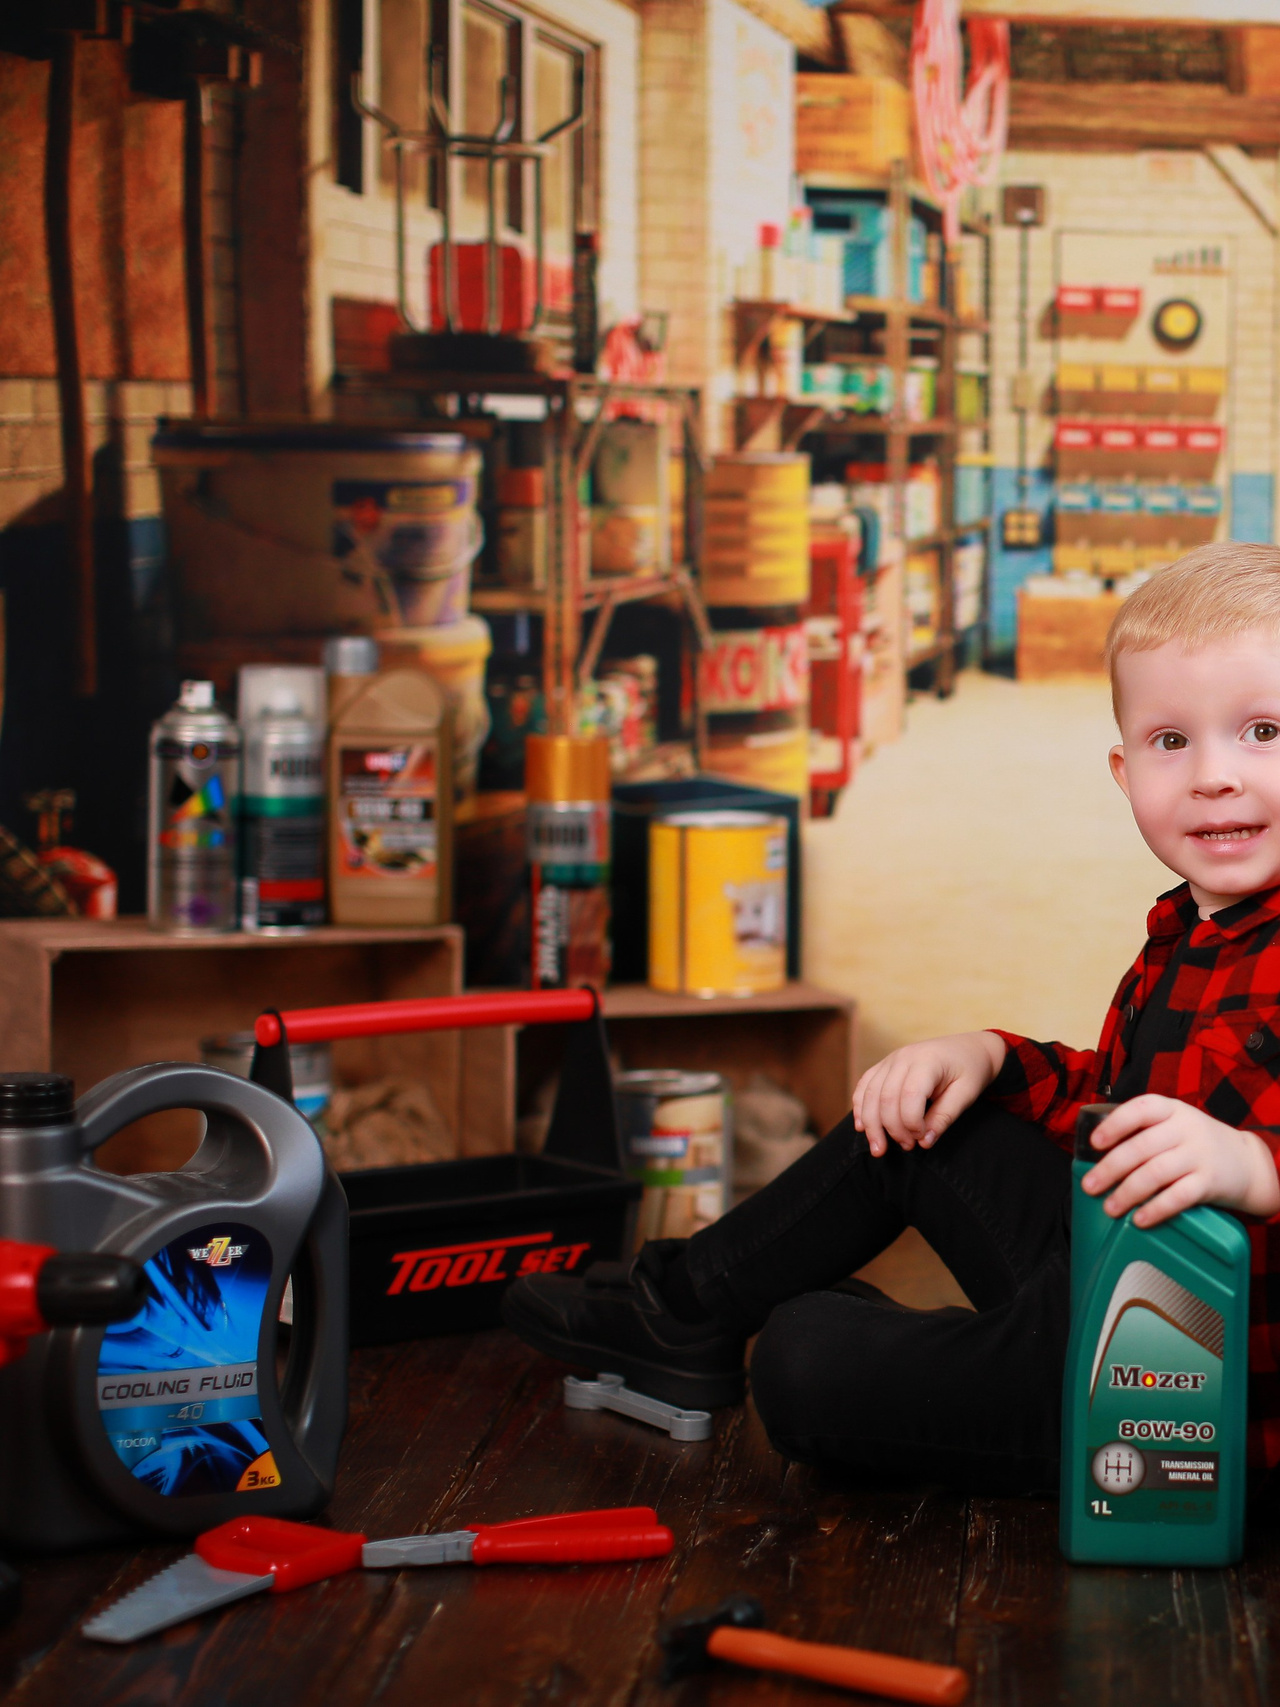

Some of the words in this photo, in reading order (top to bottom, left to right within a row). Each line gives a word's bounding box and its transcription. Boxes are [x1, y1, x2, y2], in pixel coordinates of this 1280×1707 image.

[386, 1232, 553, 1295] TOOL
[516, 1242, 590, 1277] SET
[1109, 1364, 1206, 1392] Mozer
[102, 1379, 190, 1400] COOLING
[168, 1403, 205, 1420] -40
[1119, 1419, 1216, 1443] 80W-90
[1161, 1460, 1214, 1470] TRANSMISSION
[1168, 1471, 1200, 1480] MINERAL
[1201, 1472, 1214, 1481] OIL
[1091, 1500, 1112, 1515] 1L
